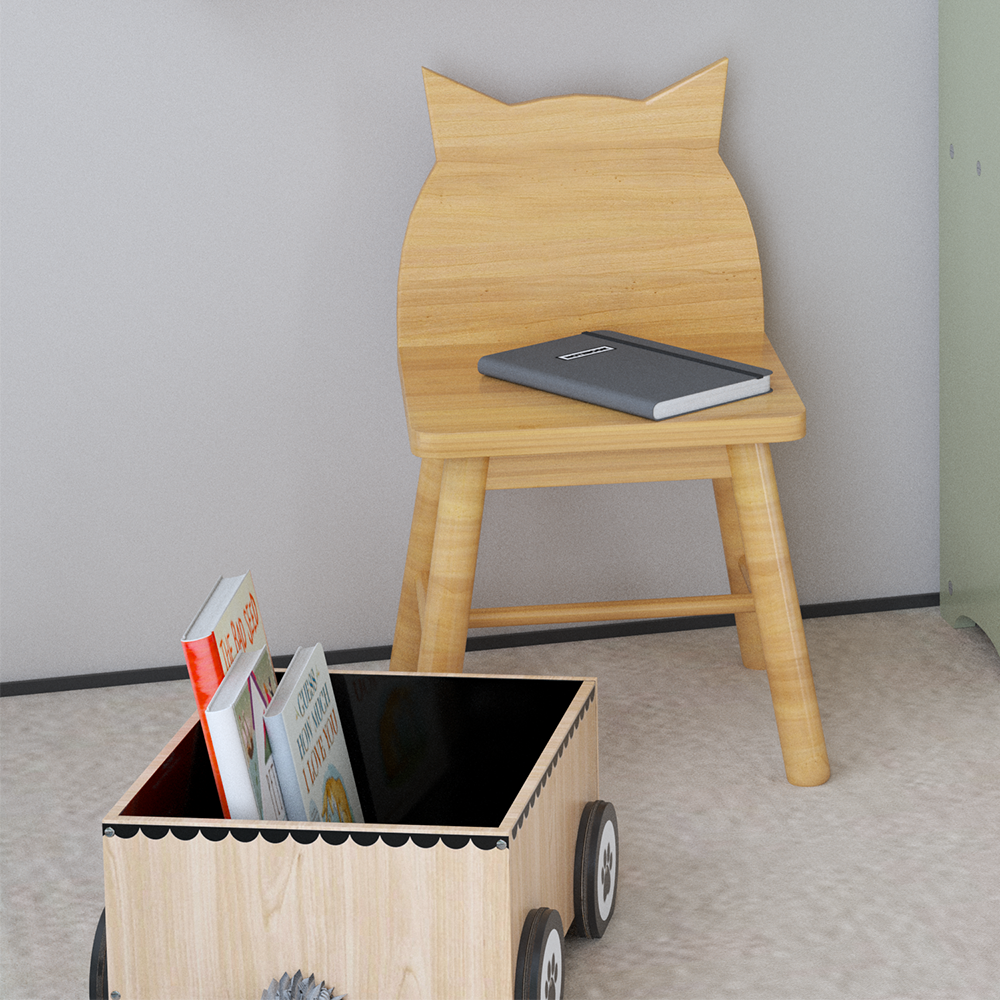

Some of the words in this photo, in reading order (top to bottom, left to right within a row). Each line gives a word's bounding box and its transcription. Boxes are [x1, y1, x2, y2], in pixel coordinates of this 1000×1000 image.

[220, 633, 234, 671] THE
[230, 617, 247, 653] BAD
[243, 592, 259, 645] SEED
[297, 668, 318, 717] GUESS
[297, 718, 313, 760] HOW
[311, 682, 331, 731] MUCH
[303, 768, 310, 793] I
[307, 736, 327, 785] LOVE
[323, 708, 338, 749] YOU
